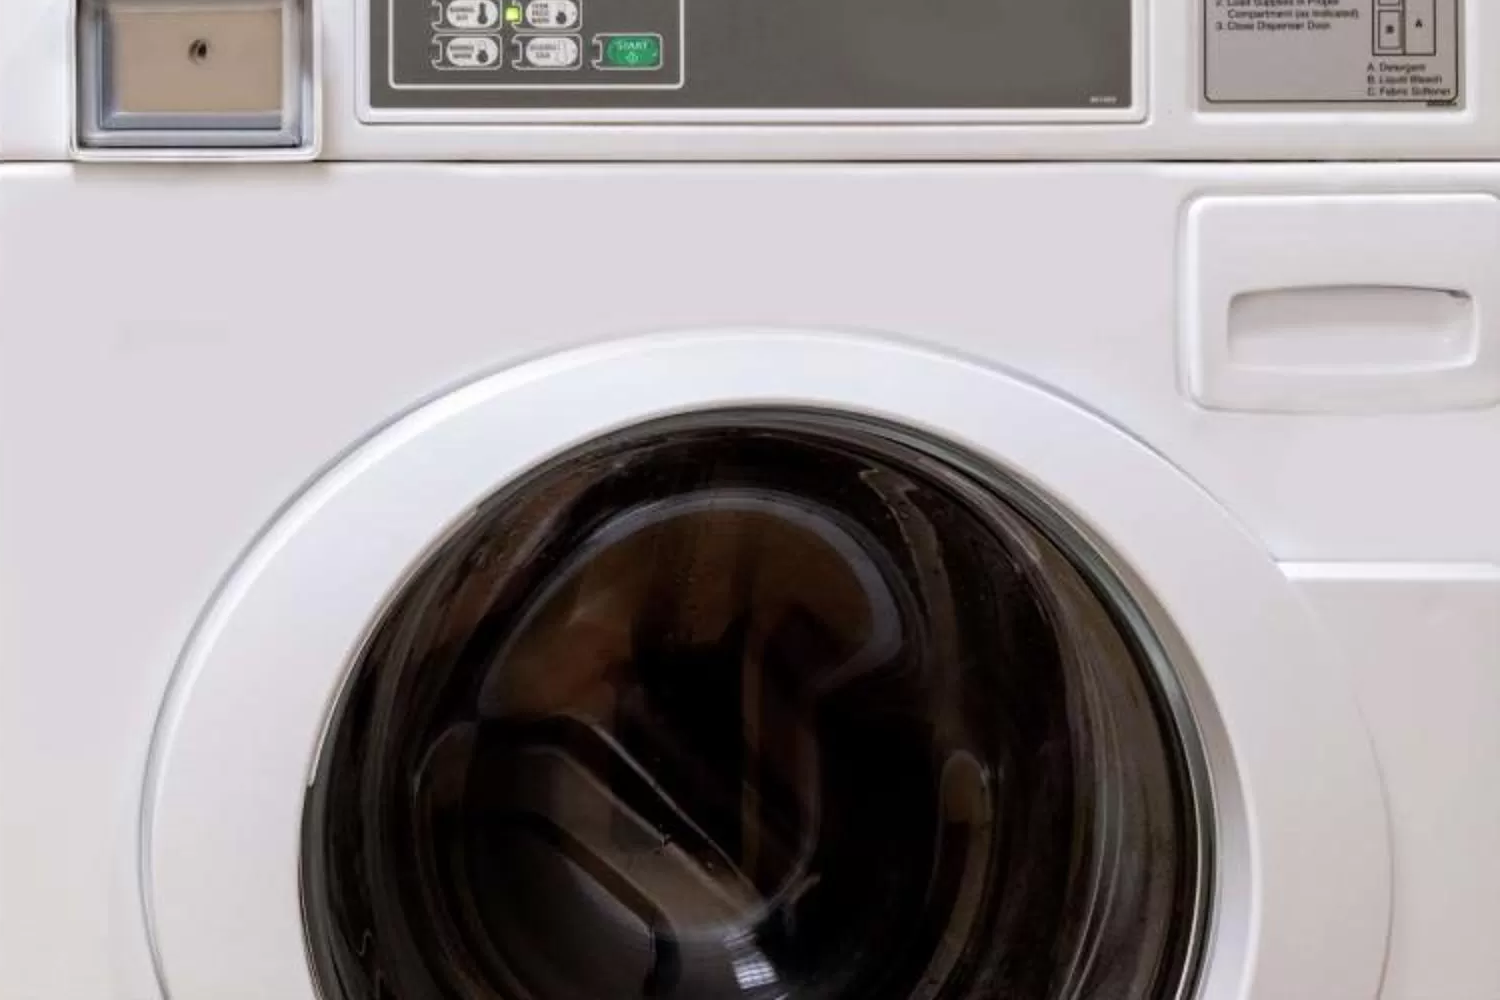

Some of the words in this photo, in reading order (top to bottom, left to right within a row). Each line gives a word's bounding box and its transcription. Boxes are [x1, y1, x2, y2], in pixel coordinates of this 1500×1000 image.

[1227, 9, 1293, 19] Compartment
[1227, 21, 1255, 31] Close
[1257, 20, 1305, 32] Dispenser
[1414, 18, 1423, 29] A
[1385, 24, 1395, 35] B
[613, 39, 652, 50] START
[1379, 62, 1427, 74] Detergent
[1379, 87, 1409, 97] Fabric
